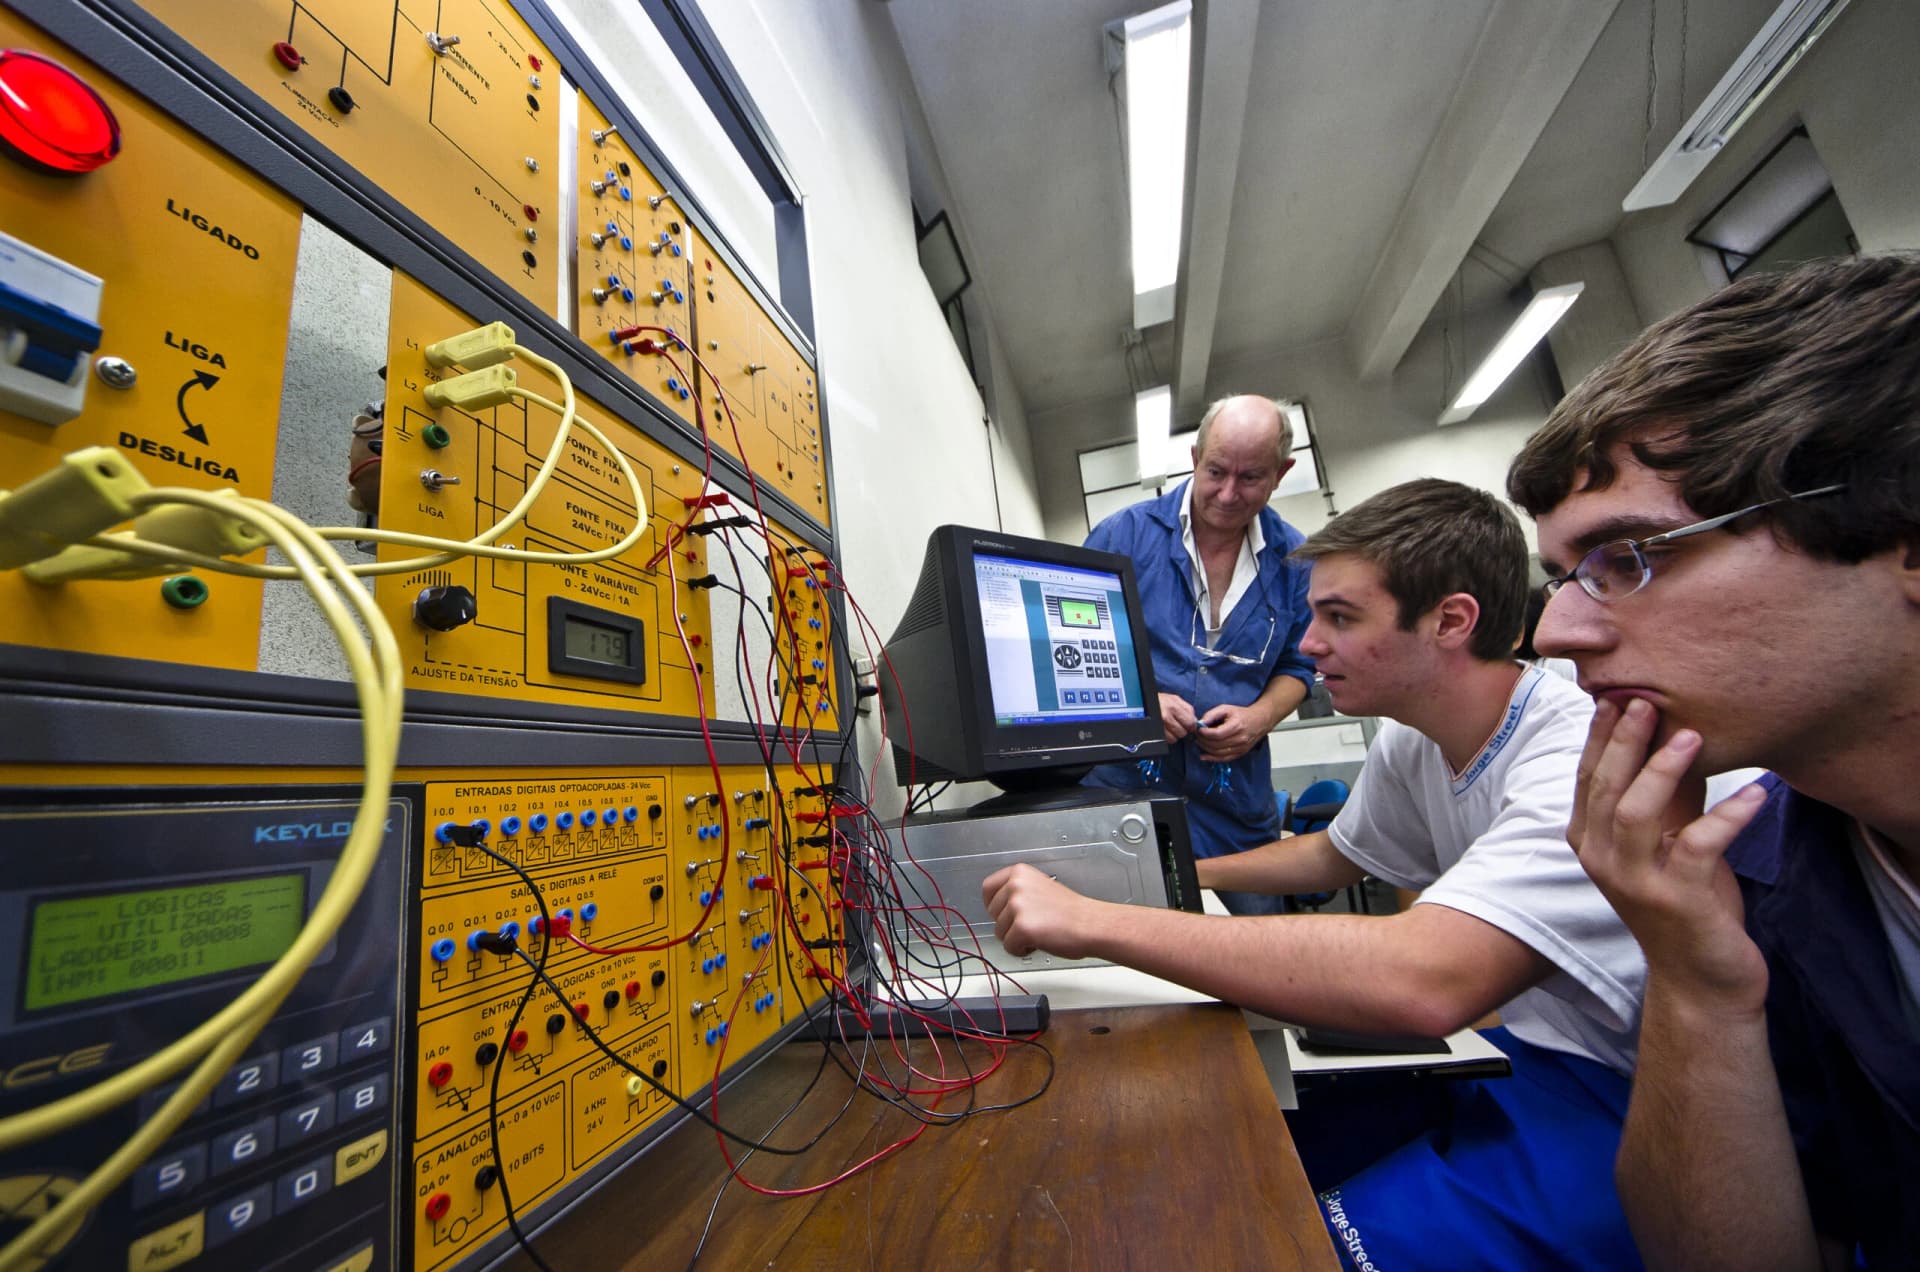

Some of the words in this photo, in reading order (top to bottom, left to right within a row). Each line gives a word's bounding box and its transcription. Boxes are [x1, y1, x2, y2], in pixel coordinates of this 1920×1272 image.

[449, 45, 490, 91] ORRENTE
[474, 186, 480, 196] 0
[490, 200, 500, 212] 10
[166, 198, 260, 260] LIGADO
[164, 330, 228, 370] LIGA
[406, 338, 418, 351] L1
[404, 378, 417, 392] L2
[118, 431, 240, 484] DESLIGA
[566, 435, 598, 460] FONTE
[602, 456, 624, 475] FIXA
[608, 474, 620, 486] 1A
[418, 503, 444, 520] LIGA
[566, 502, 600, 524] FONTE
[605, 520, 626, 536] FIXA
[564, 578, 571, 588] 0
[618, 595, 630, 607] 1A
[594, 573, 640, 596] VARIÁVEL
[412, 666, 456, 680] AJUSTE
[460, 672, 475, 683] DA
[478, 674, 518, 688] TENSÃO
[1464, 752, 1491, 784] Jorge
[1489, 704, 1520, 750] Street
[456, 786, 512, 798] ENTRADAS
[517, 784, 556, 794] DIGITAIS
[560, 782, 626, 793] OPTOACOPLADAS
[440, 808, 455, 816] 0.0
[474, 806, 487, 814] 0.1
[504, 803, 517, 812] 0.2
[532, 802, 544, 810] 0.3
[255, 818, 393, 844] KEYLO
[686, 824, 692, 834] 0
[510, 884, 546, 900] SAÍDS
[550, 875, 586, 892] DIGITAIS
[589, 874, 595, 882] A
[598, 868, 617, 880] RELÉ
[576, 892, 582, 900] Q
[584, 890, 594, 900] 0.5
[117, 889, 226, 920] LOGICAS
[525, 904, 532, 914] Q
[552, 898, 558, 906] Q
[560, 896, 570, 905] 0.4
[98, 904, 253, 940] UTILIZADAS
[464, 918, 472, 928] Q
[474, 916, 487, 926] 0.1
[496, 911, 502, 920] Q
[504, 908, 518, 918] 0.2
[428, 926, 436, 936] Q
[438, 922, 454, 934] 0.0
[648, 960, 661, 970] GND
[690, 961, 696, 973] 2
[481, 992, 536, 1020] ENTRADS
[538, 968, 596, 998] ANLÓGICAS
[601, 978, 616, 990] GND
[544, 1000, 561, 1013] GND
[356, 1028, 378, 1048] 4
[473, 1026, 494, 1042] GND
[0, 1042, 114, 1089] CE
[302, 1046, 323, 1070] 3
[424, 1048, 436, 1062] IA
[590, 1050, 631, 1080] CONTAOR
[238, 1066, 262, 1092] 2
[354, 1086, 376, 1110] 8
[298, 1106, 320, 1132] 7
[584, 1106, 589, 1115] 4
[422, 1160, 433, 1174] S.
[436, 1120, 506, 1166] ANALÓGIA
[514, 1112, 520, 1123] 0
[522, 1108, 528, 1118] a
[531, 1100, 542, 1114] 10
[544, 1091, 560, 1106] Vcc
[586, 1120, 596, 1134] 24
[598, 1114, 604, 1126] V
[232, 1132, 258, 1161] 6
[346, 1143, 380, 1170] ENT
[472, 1148, 494, 1167] GND
[508, 1159, 520, 1174] 10
[522, 1143, 545, 1166] BITS
[158, 1160, 186, 1192] 5
[294, 1170, 318, 1199] 0
[419, 1180, 436, 1198] QA
[228, 1200, 255, 1228] 9
[1328, 1198, 1350, 1230] Jorge
[144, 1230, 194, 1264] ALT
